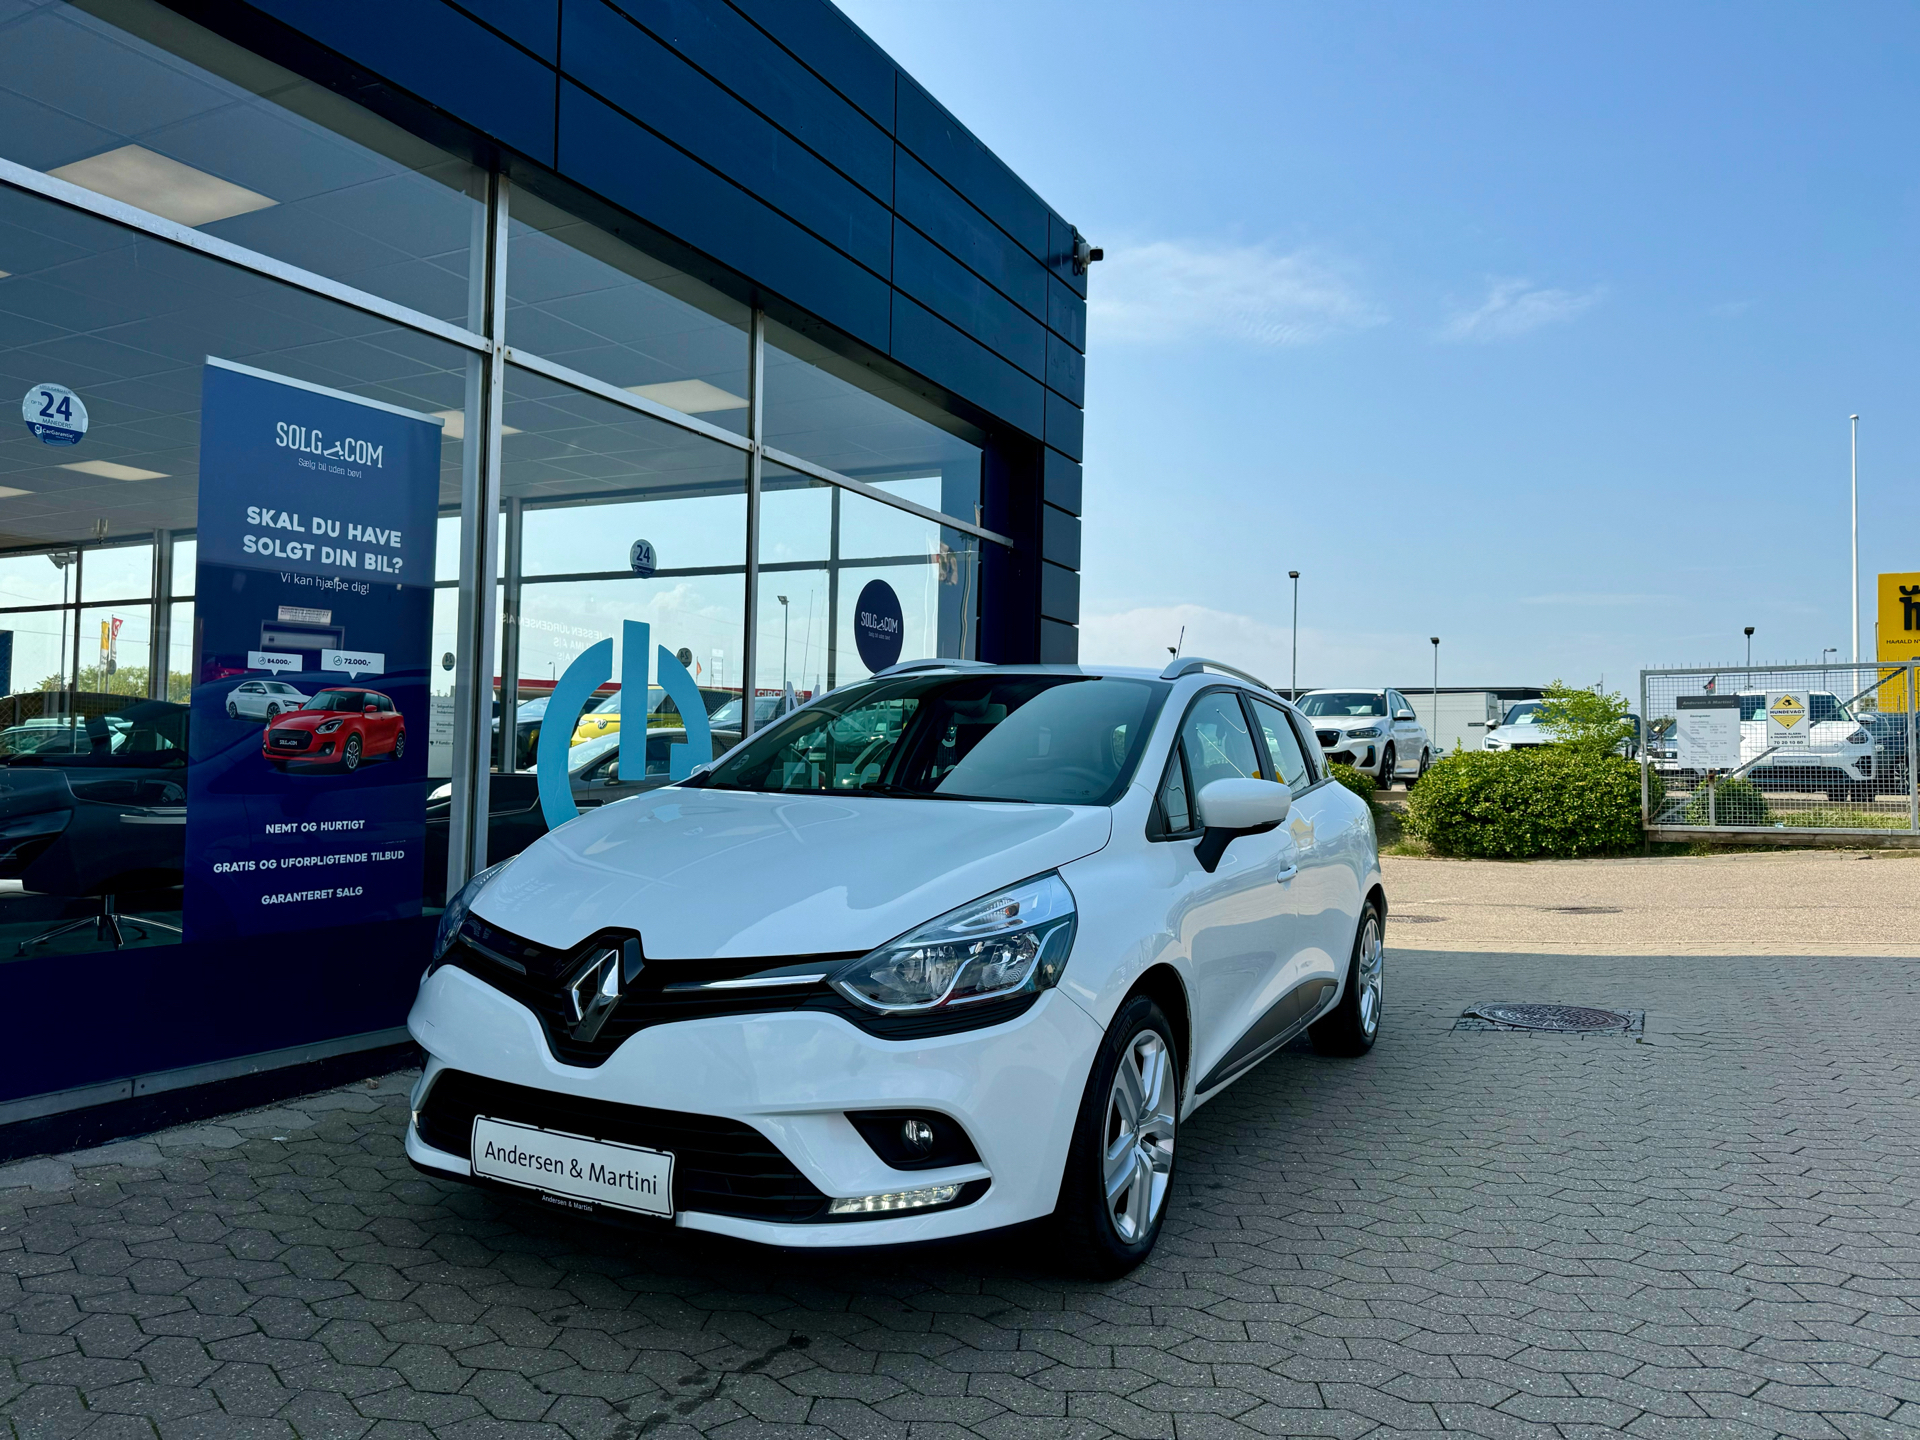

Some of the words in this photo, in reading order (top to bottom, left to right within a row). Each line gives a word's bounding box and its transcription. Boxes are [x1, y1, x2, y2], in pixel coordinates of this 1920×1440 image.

[39, 391, 72, 422] 24
[298, 458, 316, 471] Sælg
[318, 462, 327, 472] bil
[328, 465, 346, 476] uden
[246, 506, 305, 533] SKAL
[312, 517, 340, 538] DU
[348, 523, 402, 548] HAVE
[243, 534, 315, 561] SOLGT
[321, 547, 357, 568] DIN
[364, 554, 403, 574] BIL?
[636, 544, 650, 563] 24
[280, 572, 292, 584] Vi
[294, 574, 313, 587] kan
[315, 576, 349, 592] hjælpe
[351, 581, 370, 596] dig!
[265, 823, 298, 834] NEMT
[300, 822, 318, 833] OG
[320, 820, 365, 831] HURTIGT
[213, 860, 256, 874] GRATIS
[259, 859, 278, 870] OG
[280, 852, 368, 868] UFORPLIGTENDE
[371, 850, 405, 862] TILBUD
[261, 889, 334, 905] GARANTERET
[336, 886, 363, 899] SALG
[484, 1141, 564, 1175] Andersen
[569, 1158, 583, 1180] &
[589, 1162, 657, 1195] Martini
[541, 1194, 567, 1207] Andersen
[568, 1200, 573, 1208] &
[573, 1202, 593, 1212] Martini
